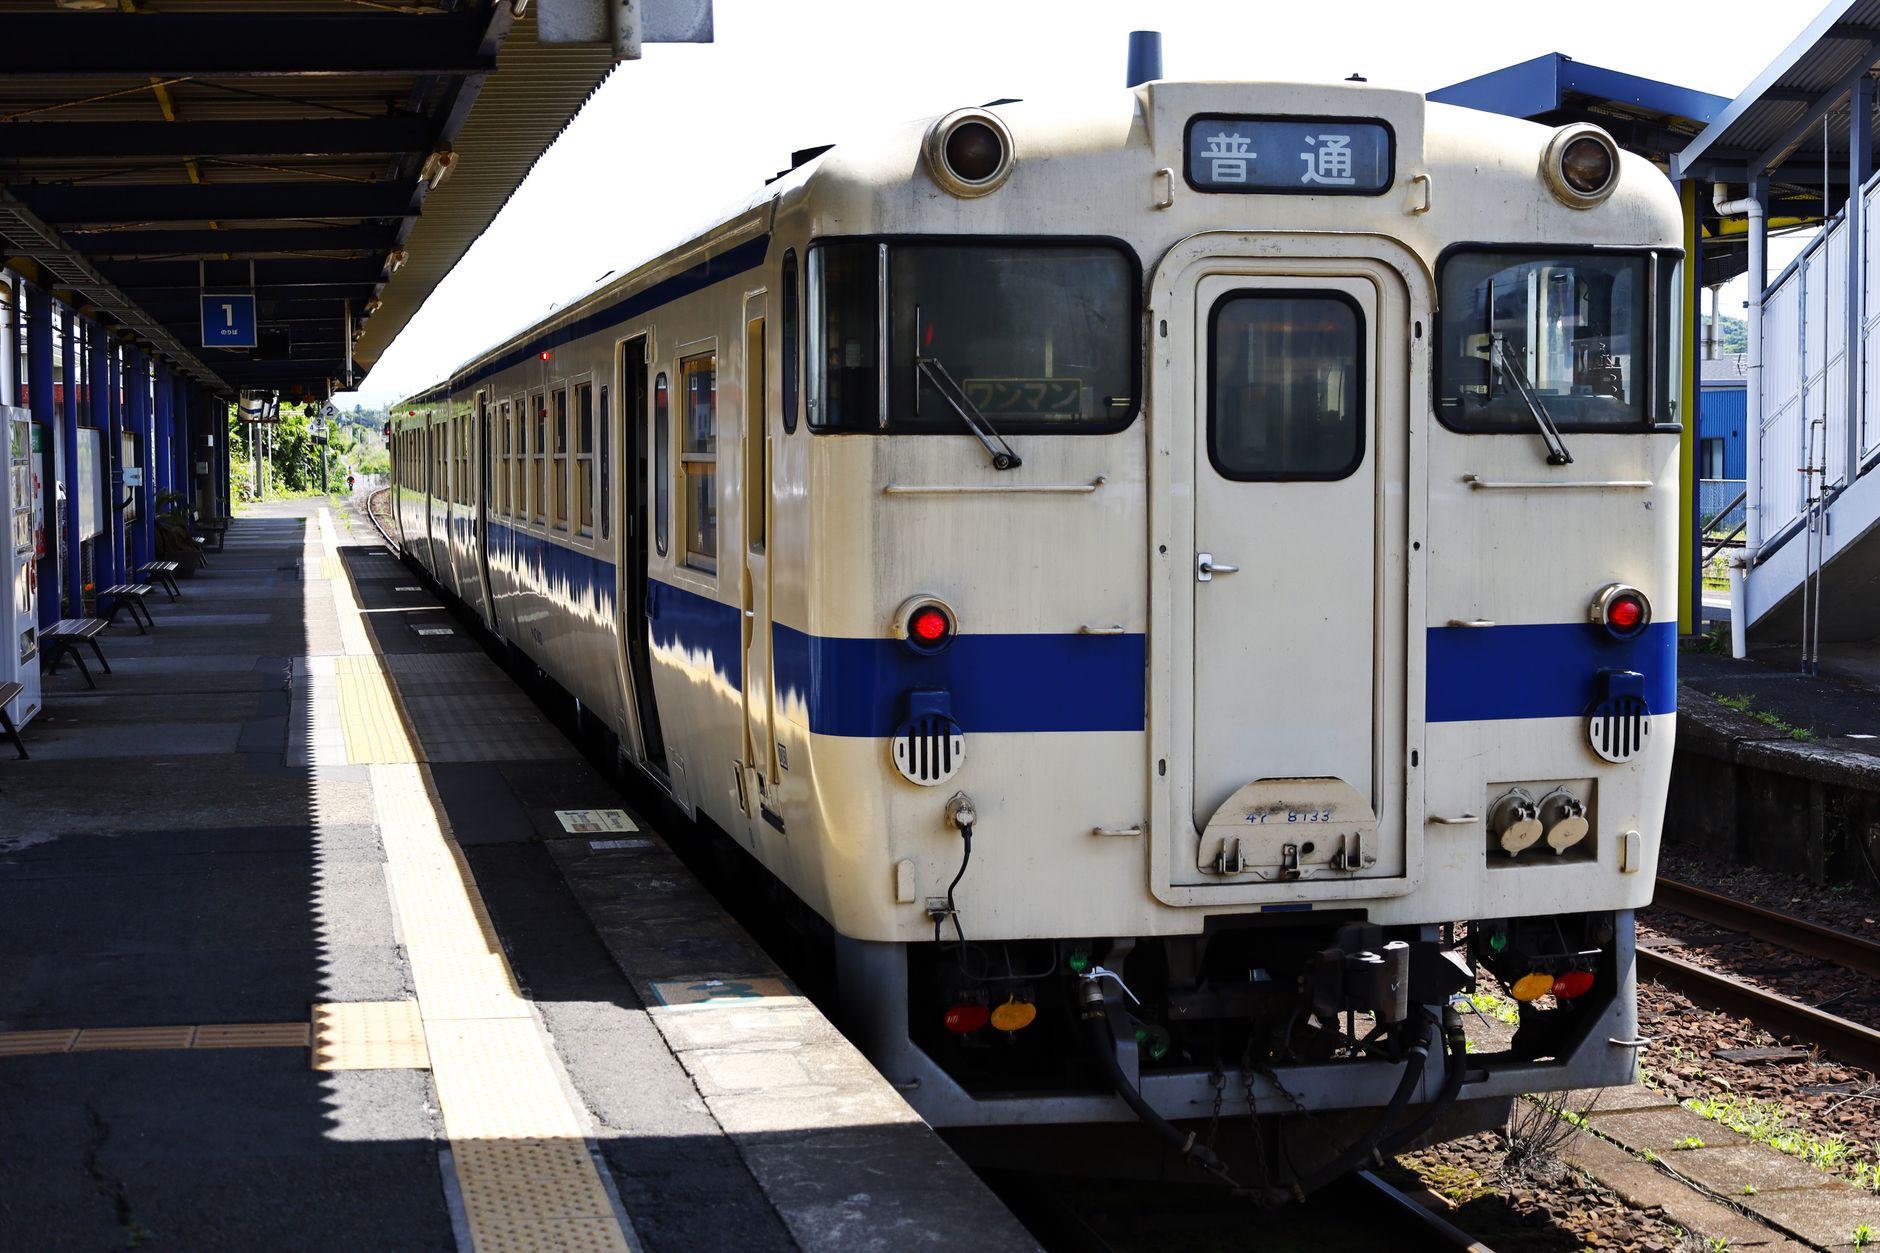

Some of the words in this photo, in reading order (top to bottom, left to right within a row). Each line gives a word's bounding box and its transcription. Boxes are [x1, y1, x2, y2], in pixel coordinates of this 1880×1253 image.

[1200, 131, 1356, 185] 普通
[222, 304, 233, 326] 1
[967, 383, 1077, 410] ワンマン
[326, 406, 333, 416] 2
